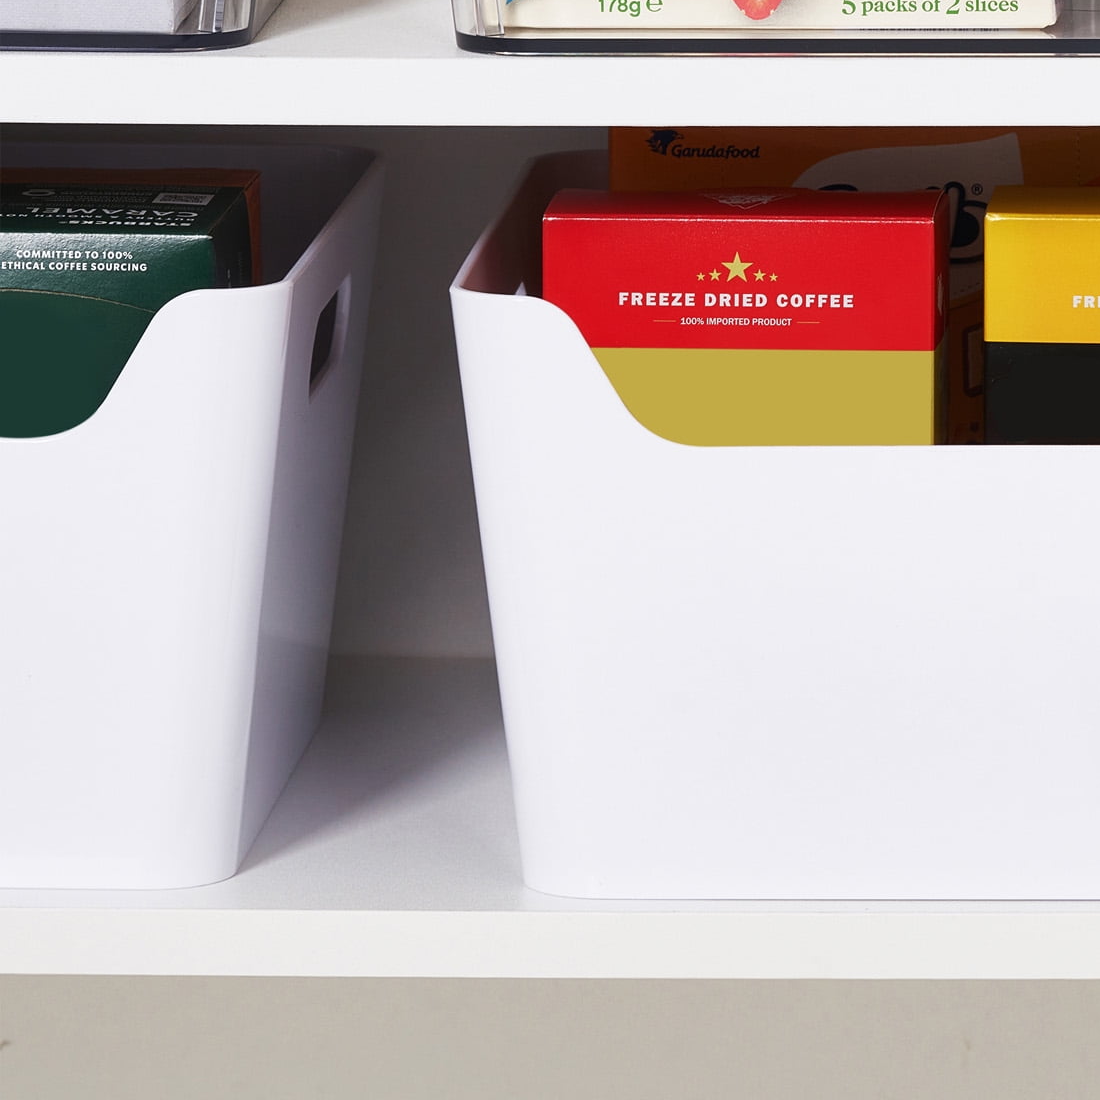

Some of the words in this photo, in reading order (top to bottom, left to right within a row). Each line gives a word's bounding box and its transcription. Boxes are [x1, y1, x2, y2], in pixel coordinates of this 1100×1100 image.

[671, 143, 761, 160] Garudafood
[26, 206, 199, 218] CARAMEL
[16, 250, 82, 259] COMMITTED
[85, 250, 100, 260] TO
[102, 250, 133, 260] 100%
[1, 261, 46, 270] ETHICAL
[48, 262, 88, 271] COFFEE
[90, 262, 148, 272] SOURCING
[618, 291, 696, 307] FREEZE
[703, 292, 768, 308] DRIED
[776, 293, 855, 309] COFFEE
[680, 316, 705, 326] 100%
[706, 316, 750, 326] IMPORTED
[751, 317, 793, 327] PRODUCT
